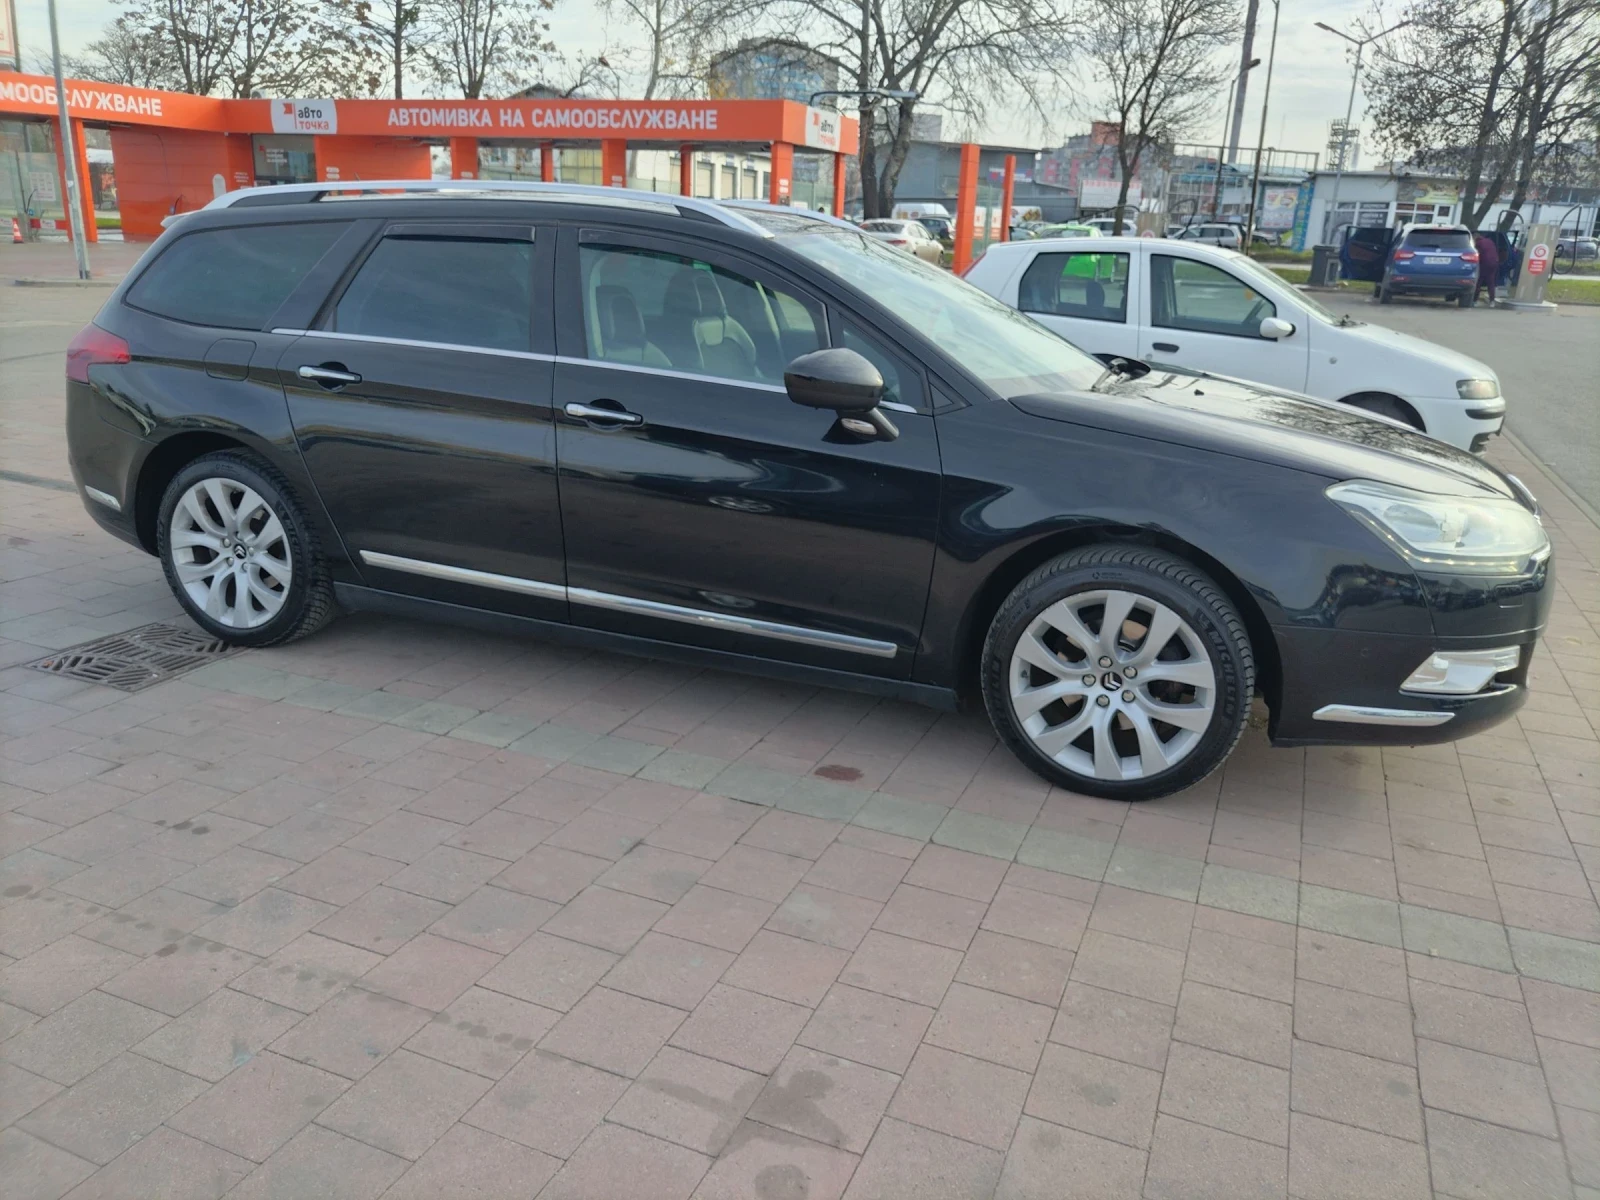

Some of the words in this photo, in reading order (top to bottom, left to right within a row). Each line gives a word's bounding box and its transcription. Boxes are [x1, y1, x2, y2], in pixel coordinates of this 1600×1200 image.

[299, 121, 329, 130] точка
[388, 108, 493, 127] АВТОМИВКА
[500, 108, 525, 128] НА
[531, 108, 718, 130] САМООБСЛУЖВАНЕ
[1208, 631, 1236, 715] MICHELIN
